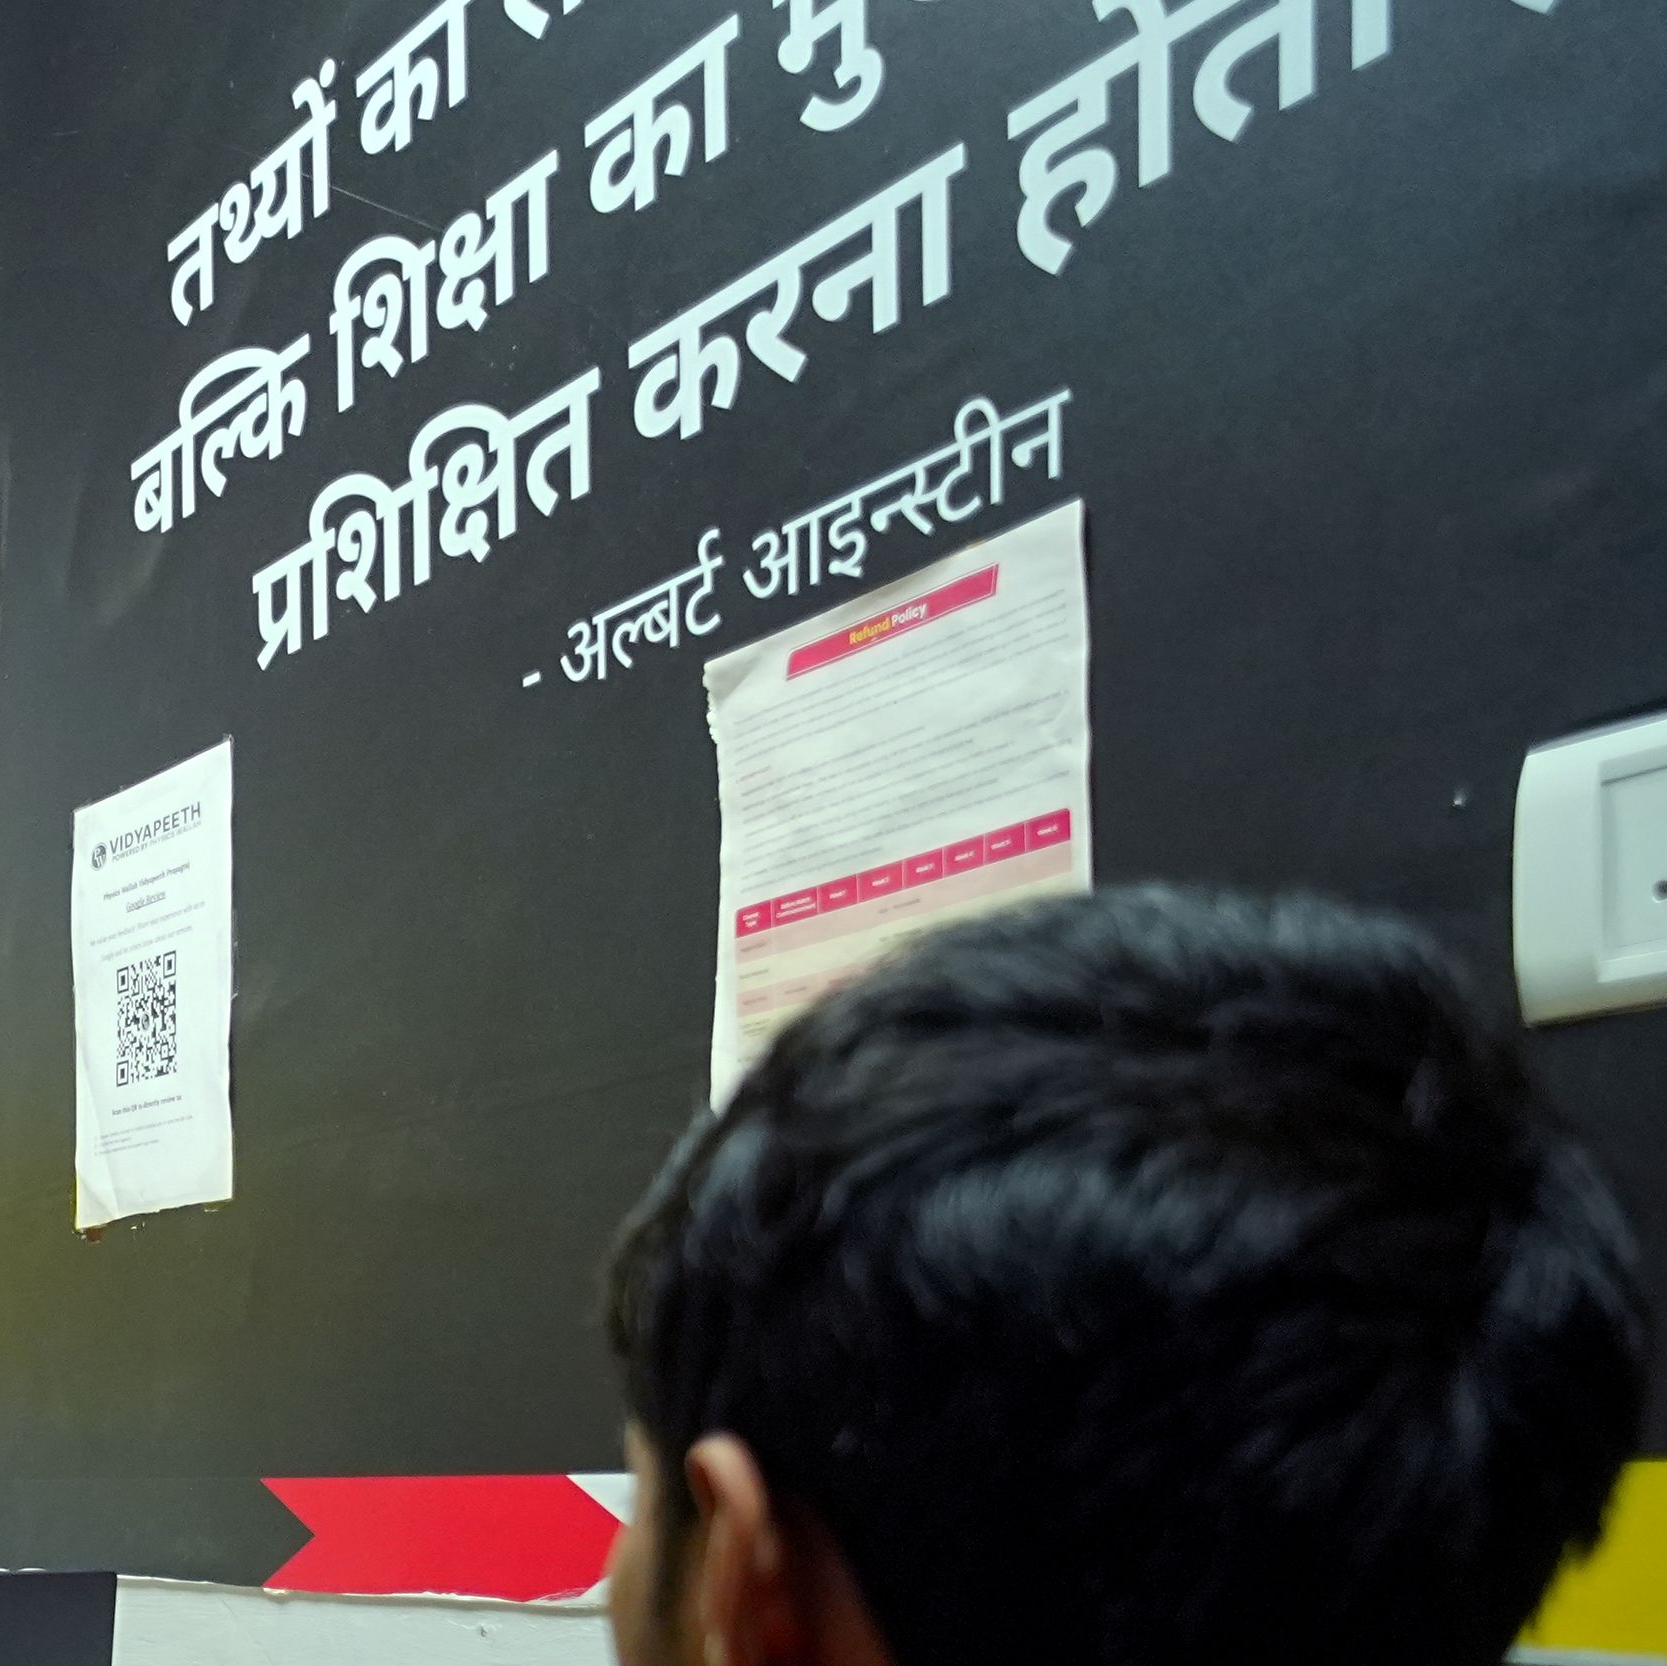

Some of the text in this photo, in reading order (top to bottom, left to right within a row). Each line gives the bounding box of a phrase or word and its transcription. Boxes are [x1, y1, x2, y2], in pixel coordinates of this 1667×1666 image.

[131, 333, 311, 534] बल्कि
[329, 149, 560, 413] शिक्षा
[584, 12, 742, 214] का
[167, 0, 473, 327] तथ्यों का
[252, 367, 601, 671] प्रशिक्षित
[628, 142, 967, 441] करना
[560, 528, 724, 682] अल्बर्ट
[743, 389, 1072, 599] आइन्स्टीन
[849, 603, 927, 645] Refund Policy
[110, 801, 201, 854] VIDYAPEETH
